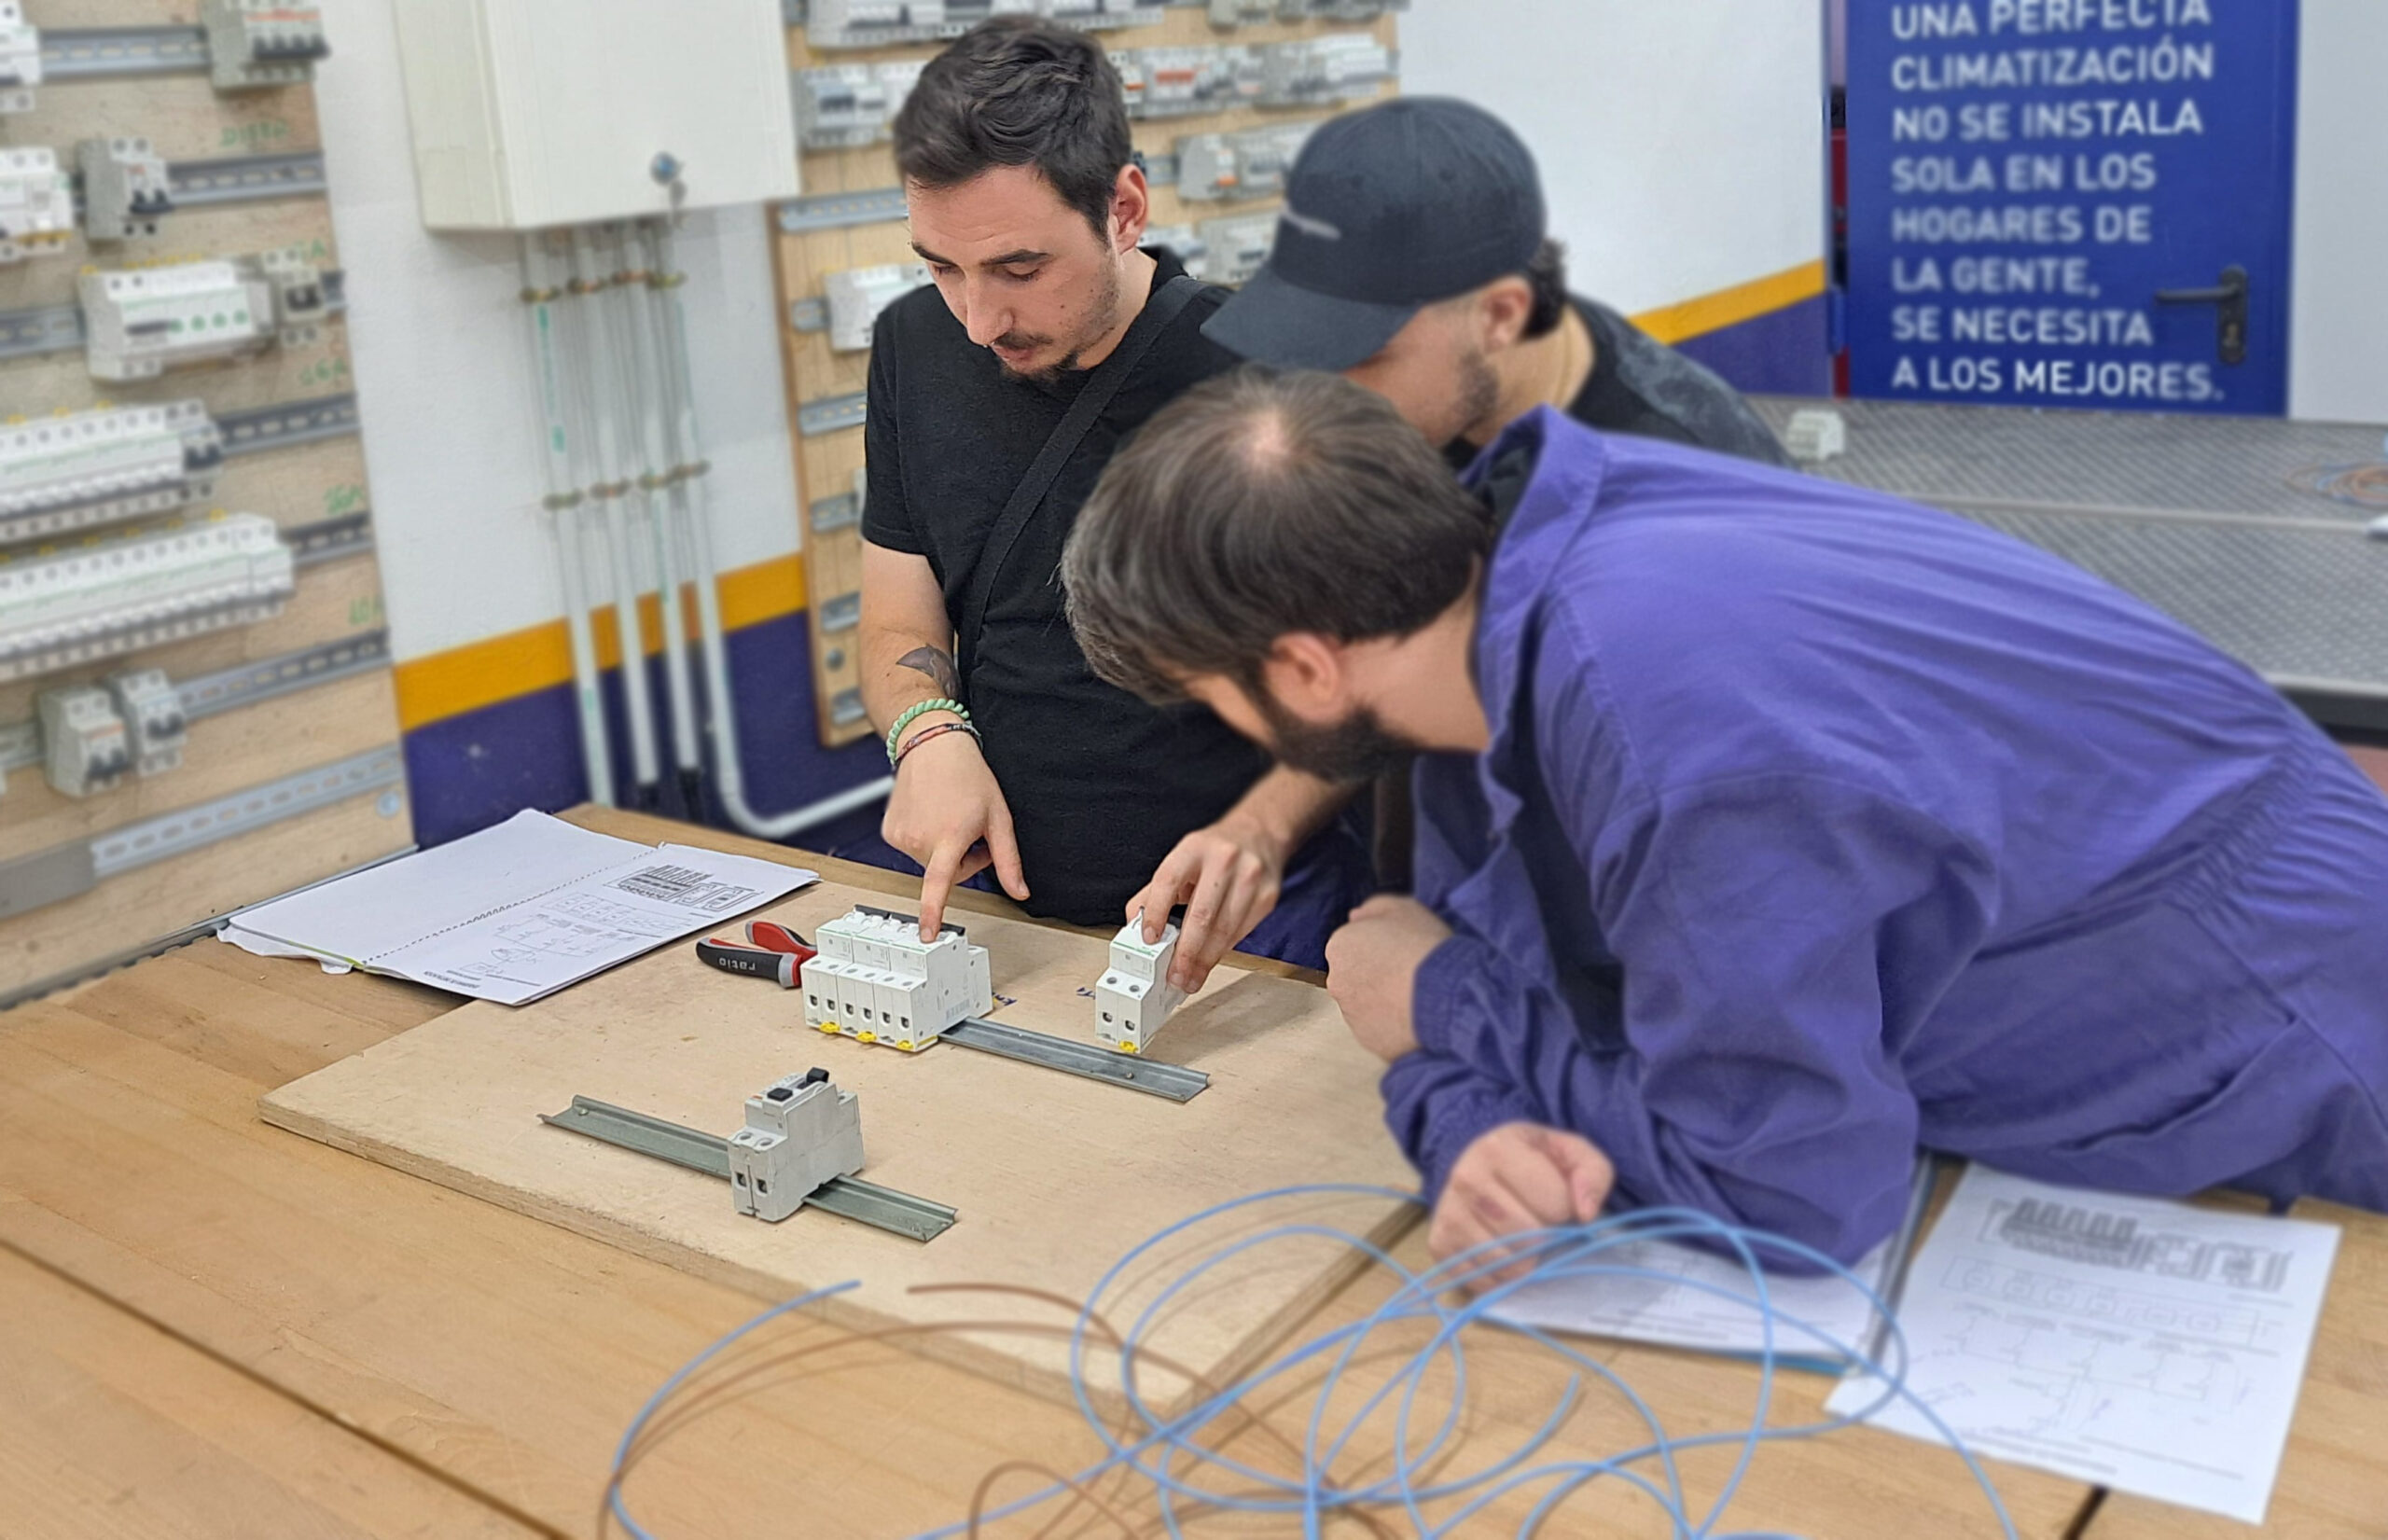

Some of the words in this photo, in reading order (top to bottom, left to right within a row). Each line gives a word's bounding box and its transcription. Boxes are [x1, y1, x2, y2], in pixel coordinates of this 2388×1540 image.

[1891, 2, 1978, 40] UNA
[1988, 0, 2212, 35] PERFECTA
[1891, 34, 2214, 91] CLIMATIZACIÓN
[1892, 106, 1950, 142] NO
[1960, 103, 2009, 141] SE
[2022, 99, 2203, 139] INSTALA
[1892, 156, 1994, 193] SOLA
[2006, 154, 2062, 191] EN
[2076, 153, 2157, 190] LOS
[1892, 207, 2083, 243] HOGARES
[2096, 205, 2151, 243] DE
[1893, 257, 1941, 293] LA
[1951, 257, 2100, 298] GENTE,
[1893, 307, 1939, 341] SE
[1952, 308, 2153, 345] NECESITA
[1893, 356, 1918, 388] A
[1929, 357, 2002, 392] LOS
[2015, 359, 2224, 401] MEJORES.
[718, 957, 756, 971] ratio
